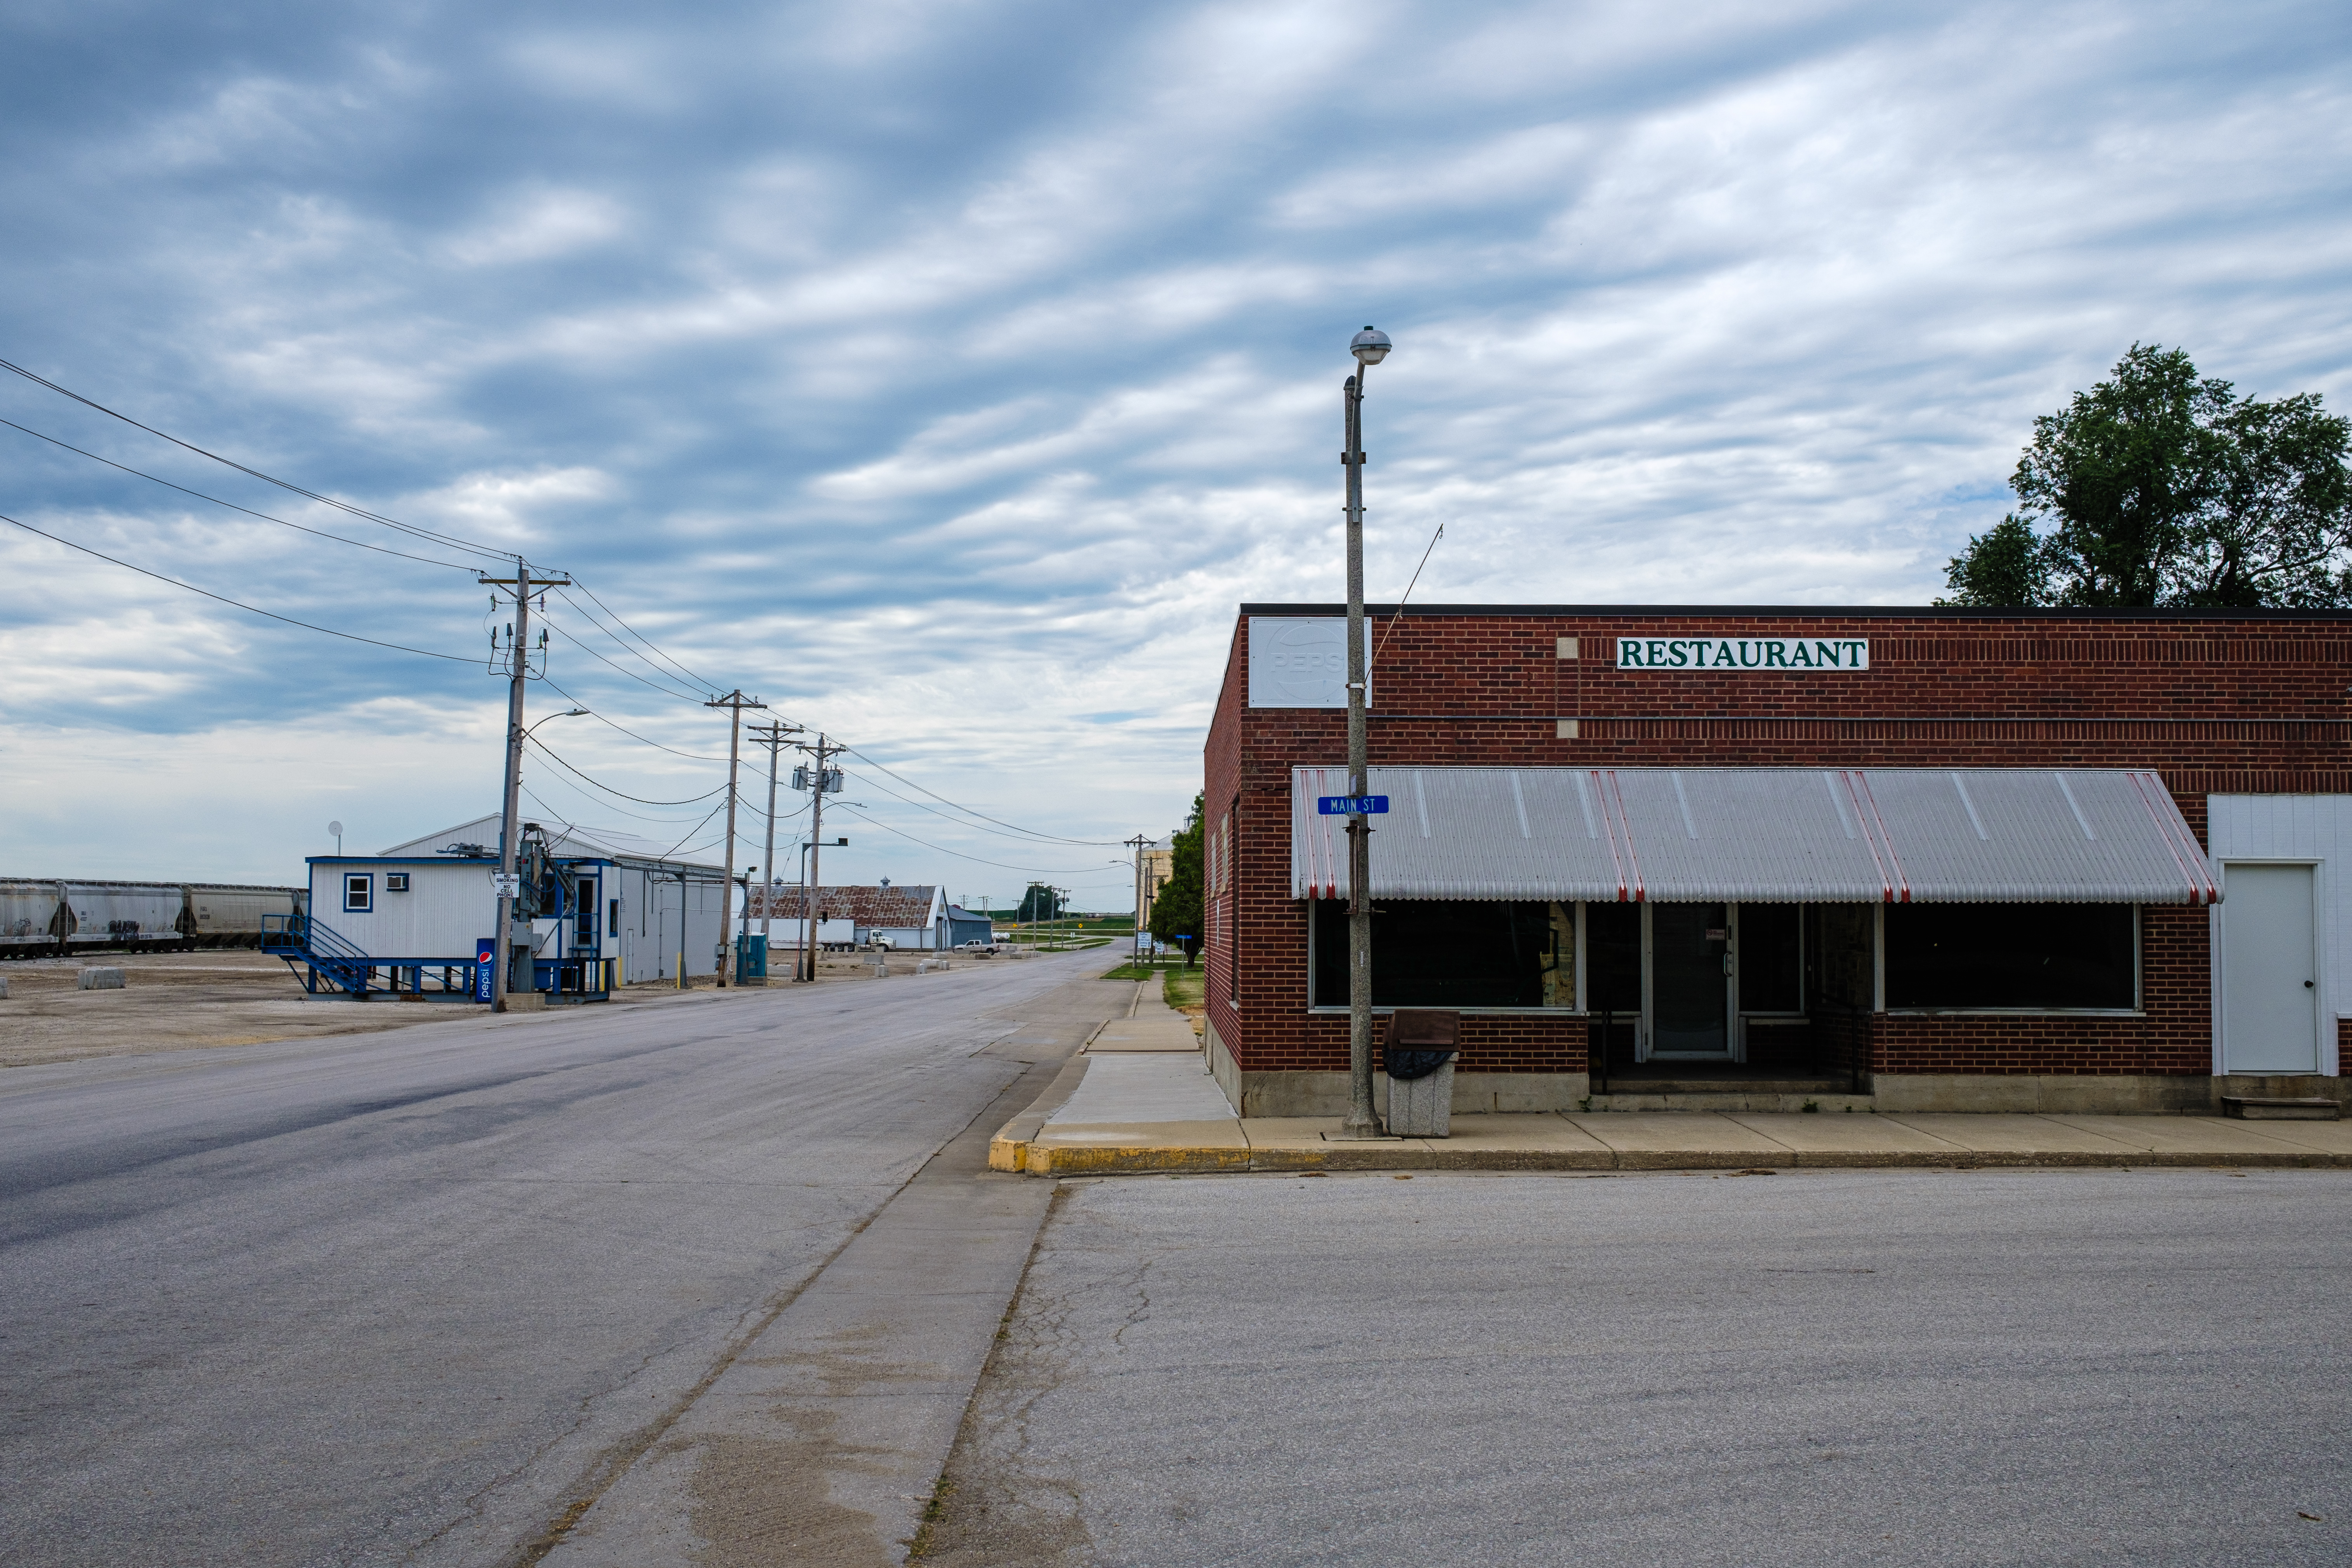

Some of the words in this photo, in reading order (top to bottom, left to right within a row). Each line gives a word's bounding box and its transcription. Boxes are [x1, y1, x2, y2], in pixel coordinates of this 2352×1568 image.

[1271, 653, 1347, 673] PEPS
[1620, 641, 1866, 667] RESTAURANT
[1331, 799, 1357, 812] MAIN
[1363, 799, 1375, 811] ST
[481, 969, 491, 998] pepsi
